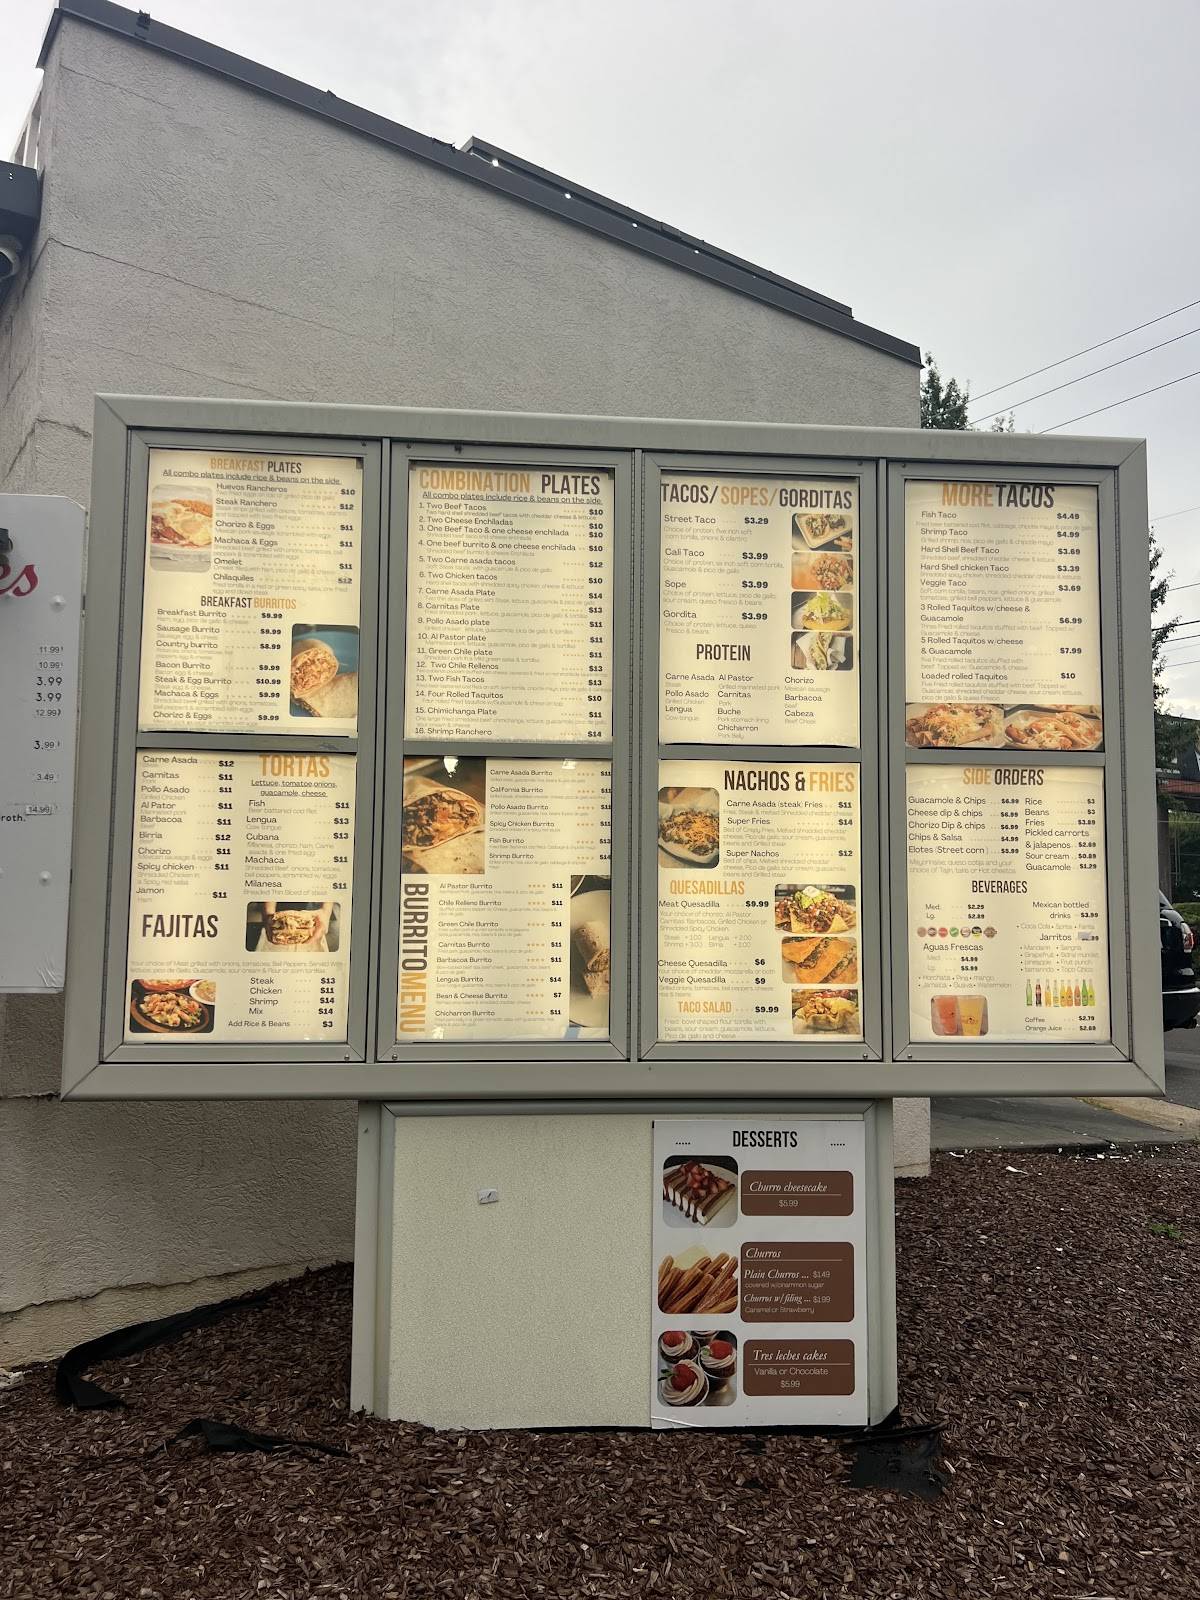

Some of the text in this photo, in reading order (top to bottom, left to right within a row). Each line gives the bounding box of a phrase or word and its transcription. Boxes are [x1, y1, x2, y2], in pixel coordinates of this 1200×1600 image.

[210, 458, 301, 473] BREAKFAST PLATES
[420, 470, 600, 495] COMBINATION PLATES
[217, 483, 245, 491] Huevos
[247, 485, 287, 493] Rancheros
[779, 489, 852, 509] GORDITAS
[942, 484, 1055, 508] MORE TACOS
[445, 517, 473, 525] Cheese
[664, 515, 692, 523] Street
[695, 516, 716, 524] Taco
[665, 548, 681, 556] Cali
[683, 549, 704, 557] Taco
[665, 580, 686, 589] Sope
[201, 596, 296, 609] BREAKFAST BURRITOS
[664, 610, 696, 619] Gordita
[697, 644, 750, 661] PROTEIN
[36, 677, 62, 685] 3.99
[975, 673, 1008, 681] Taquitos
[36, 693, 62, 701] 3.99
[143, 756, 169, 764] Carne
[171, 756, 197, 764] Asada
[260, 755, 330, 777] TORTAS
[725, 770, 855, 792] NACHOS & FRIES
[963, 769, 1044, 785] SIDE ORDERS
[940, 810, 952, 818] dip
[962, 810, 982, 818] chips
[247, 816, 277, 824] Lengua
[728, 818, 750, 826] Super
[247, 833, 279, 841] Cubana
[726, 850, 749, 858] Super
[245, 856, 284, 864] Machaca
[138, 863, 194, 871] Spicy chicken
[245, 880, 282, 888] Milanesa
[670, 880, 744, 895] QUESADILLAS
[972, 881, 1028, 893] BEVERAGES
[142, 915, 219, 938] FAJITAS
[923, 944, 948, 952] Aguas
[400, 884, 428, 1032] BURRITO MENU
[250, 977, 274, 985] Steak
[659, 976, 684, 984] Veggie
[687, 976, 726, 984] Quesadilla
[250, 987, 282, 995] Chicken
[249, 998, 278, 1006] Shrimp
[249, 1007, 263, 1015] Mix
[678, 1002, 700, 1013] TACO
[703, 1002, 731, 1013] SALAD
[733, 1131, 797, 1147] DESSERTS
[750, 1182, 827, 1192] Churro cheesecake
[746, 1248, 781, 1258] Churros
[744, 1270, 799, 1279] Plain Churros
[744, 1294, 771, 1303] Churros
[753, 1350, 827, 1360] Tres leches cakes
